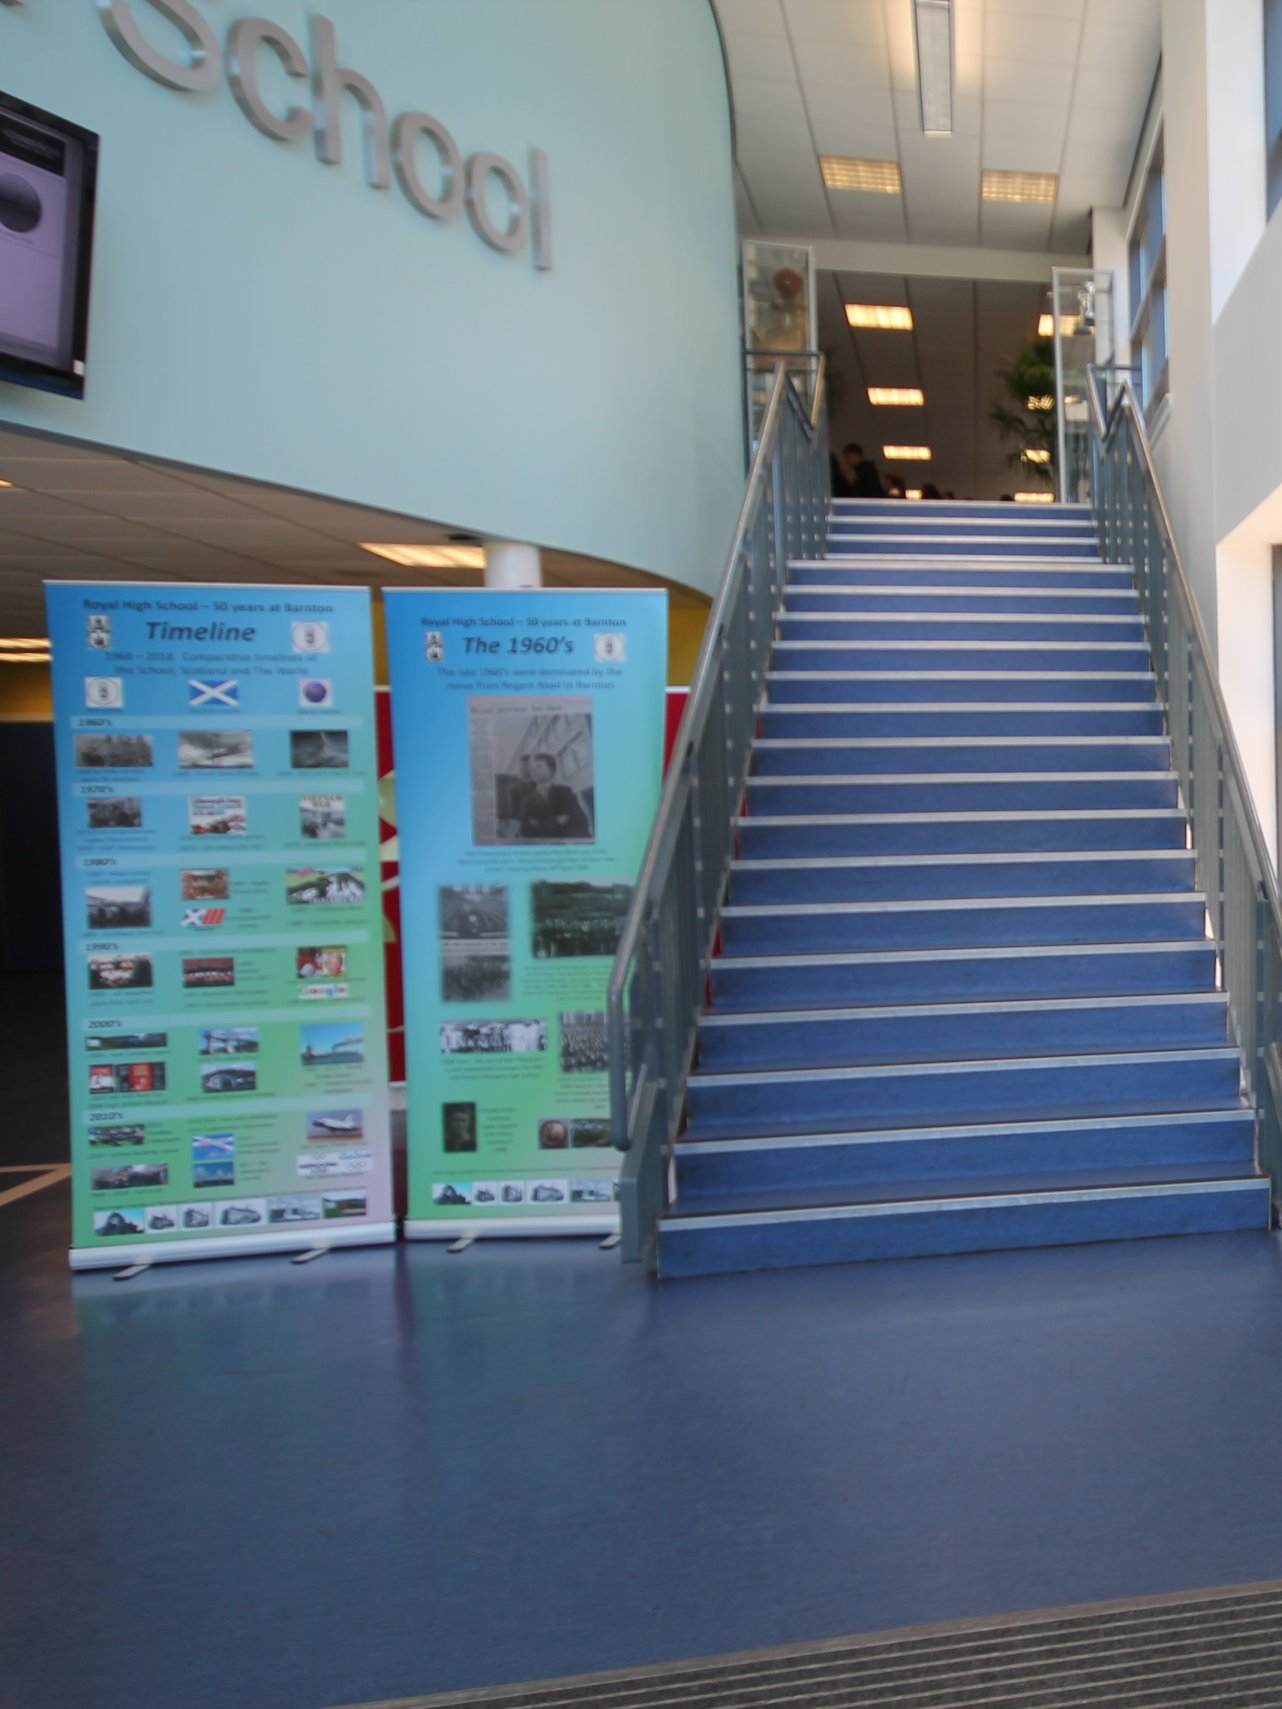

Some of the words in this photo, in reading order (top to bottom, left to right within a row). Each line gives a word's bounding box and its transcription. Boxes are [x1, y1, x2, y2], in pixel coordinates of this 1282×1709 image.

[146, 621, 256, 642] Timeline
[463, 636, 501, 654] The
[507, 636, 575, 654] 1960's
